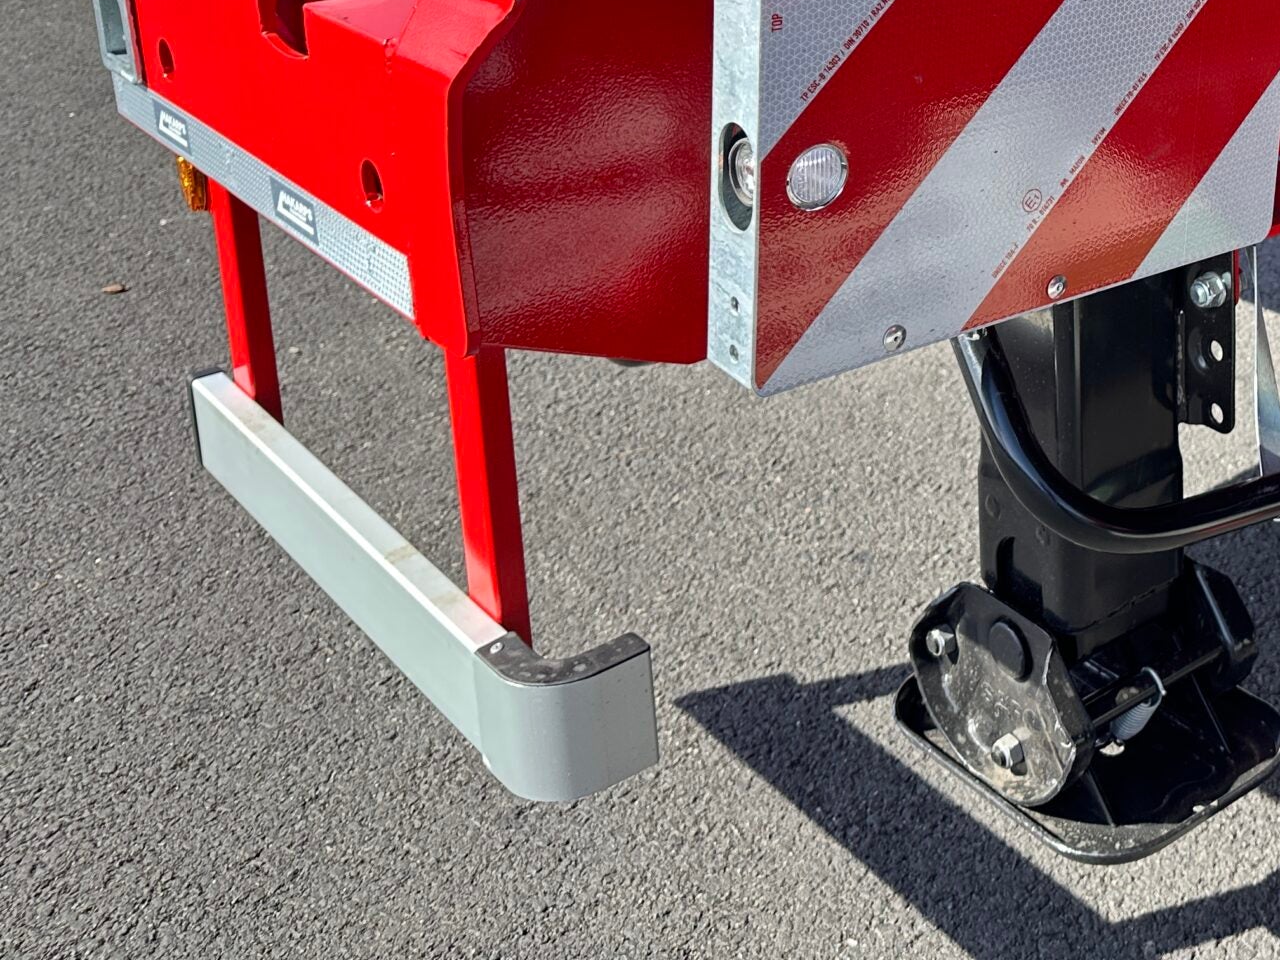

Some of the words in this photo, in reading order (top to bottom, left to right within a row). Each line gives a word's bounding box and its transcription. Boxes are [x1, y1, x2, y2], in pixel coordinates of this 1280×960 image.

[771, 13, 783, 32] TOP
[800, 91, 810, 102] TP
[807, 72, 826, 93] ESC-B
[823, 54, 841, 73] 14303
[843, 36, 855, 49] DIN
[852, 19, 870, 39] 30710
